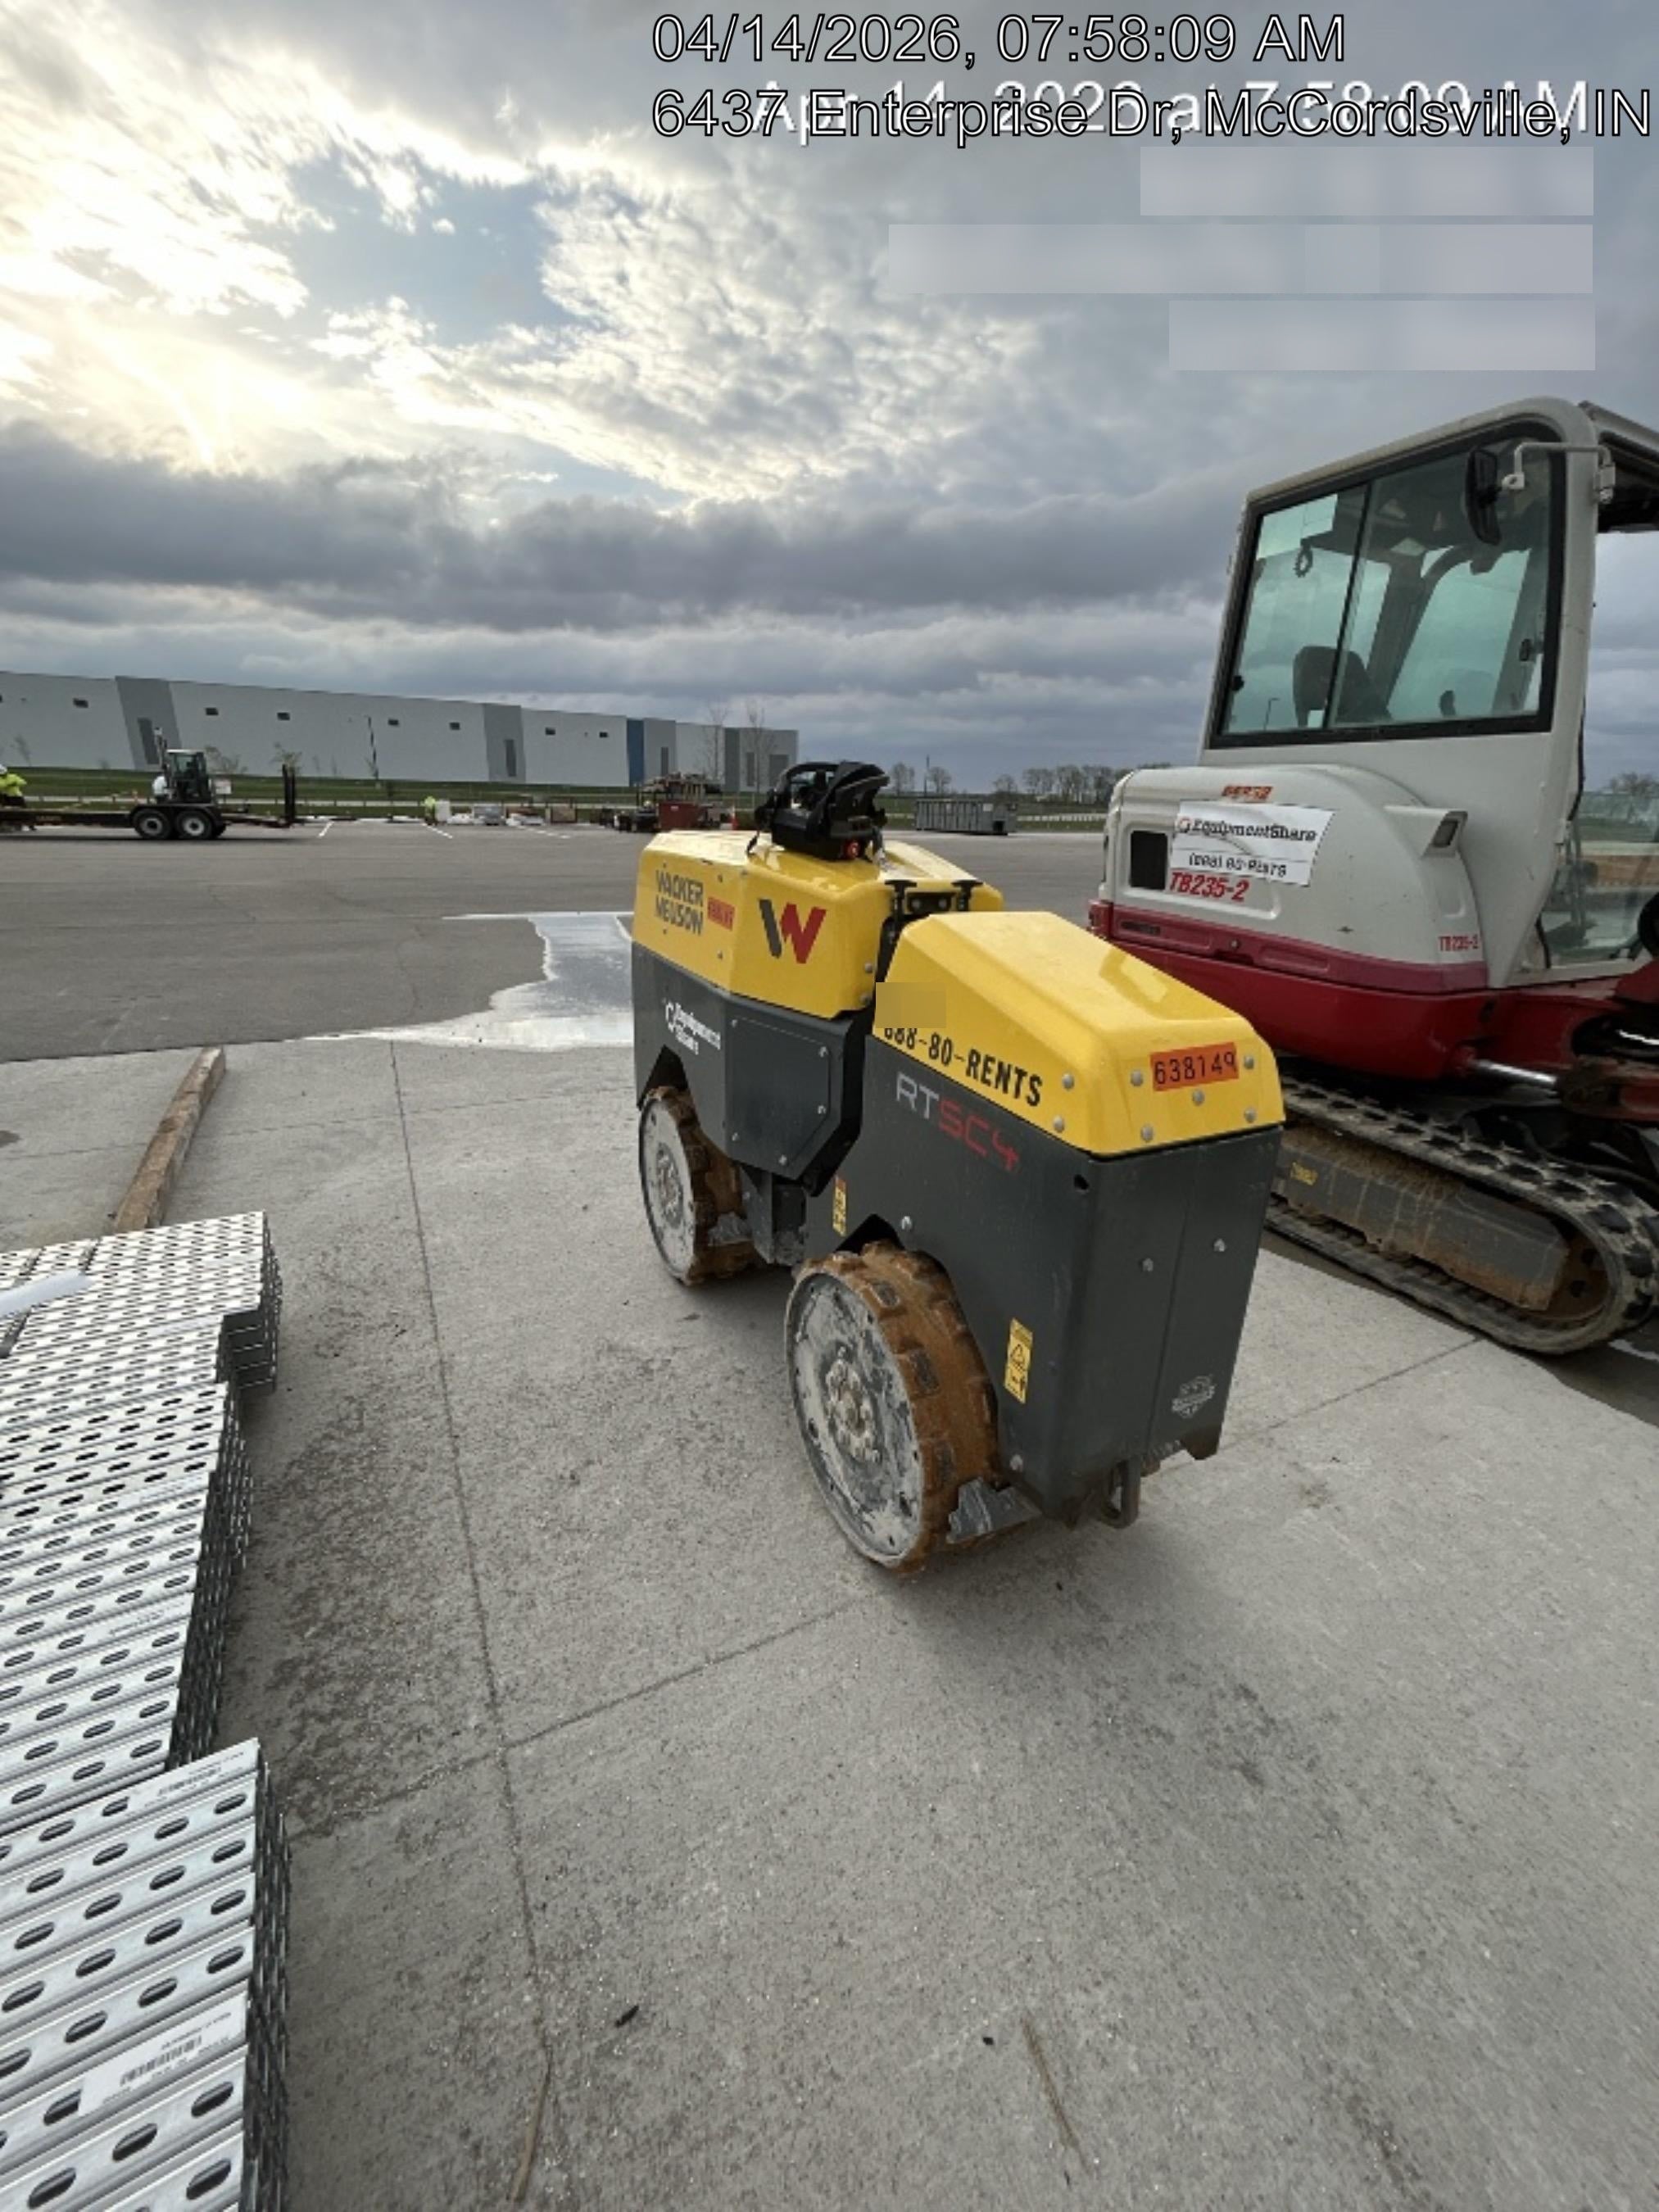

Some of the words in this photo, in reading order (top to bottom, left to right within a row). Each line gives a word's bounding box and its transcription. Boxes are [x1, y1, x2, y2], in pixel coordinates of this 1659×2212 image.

[655, 869, 704, 907] WACKER
[1170, 872, 1249, 902] TB235-2
[655, 895, 704, 936] NEUSON
[1154, 1051, 1237, 1085] 638149
